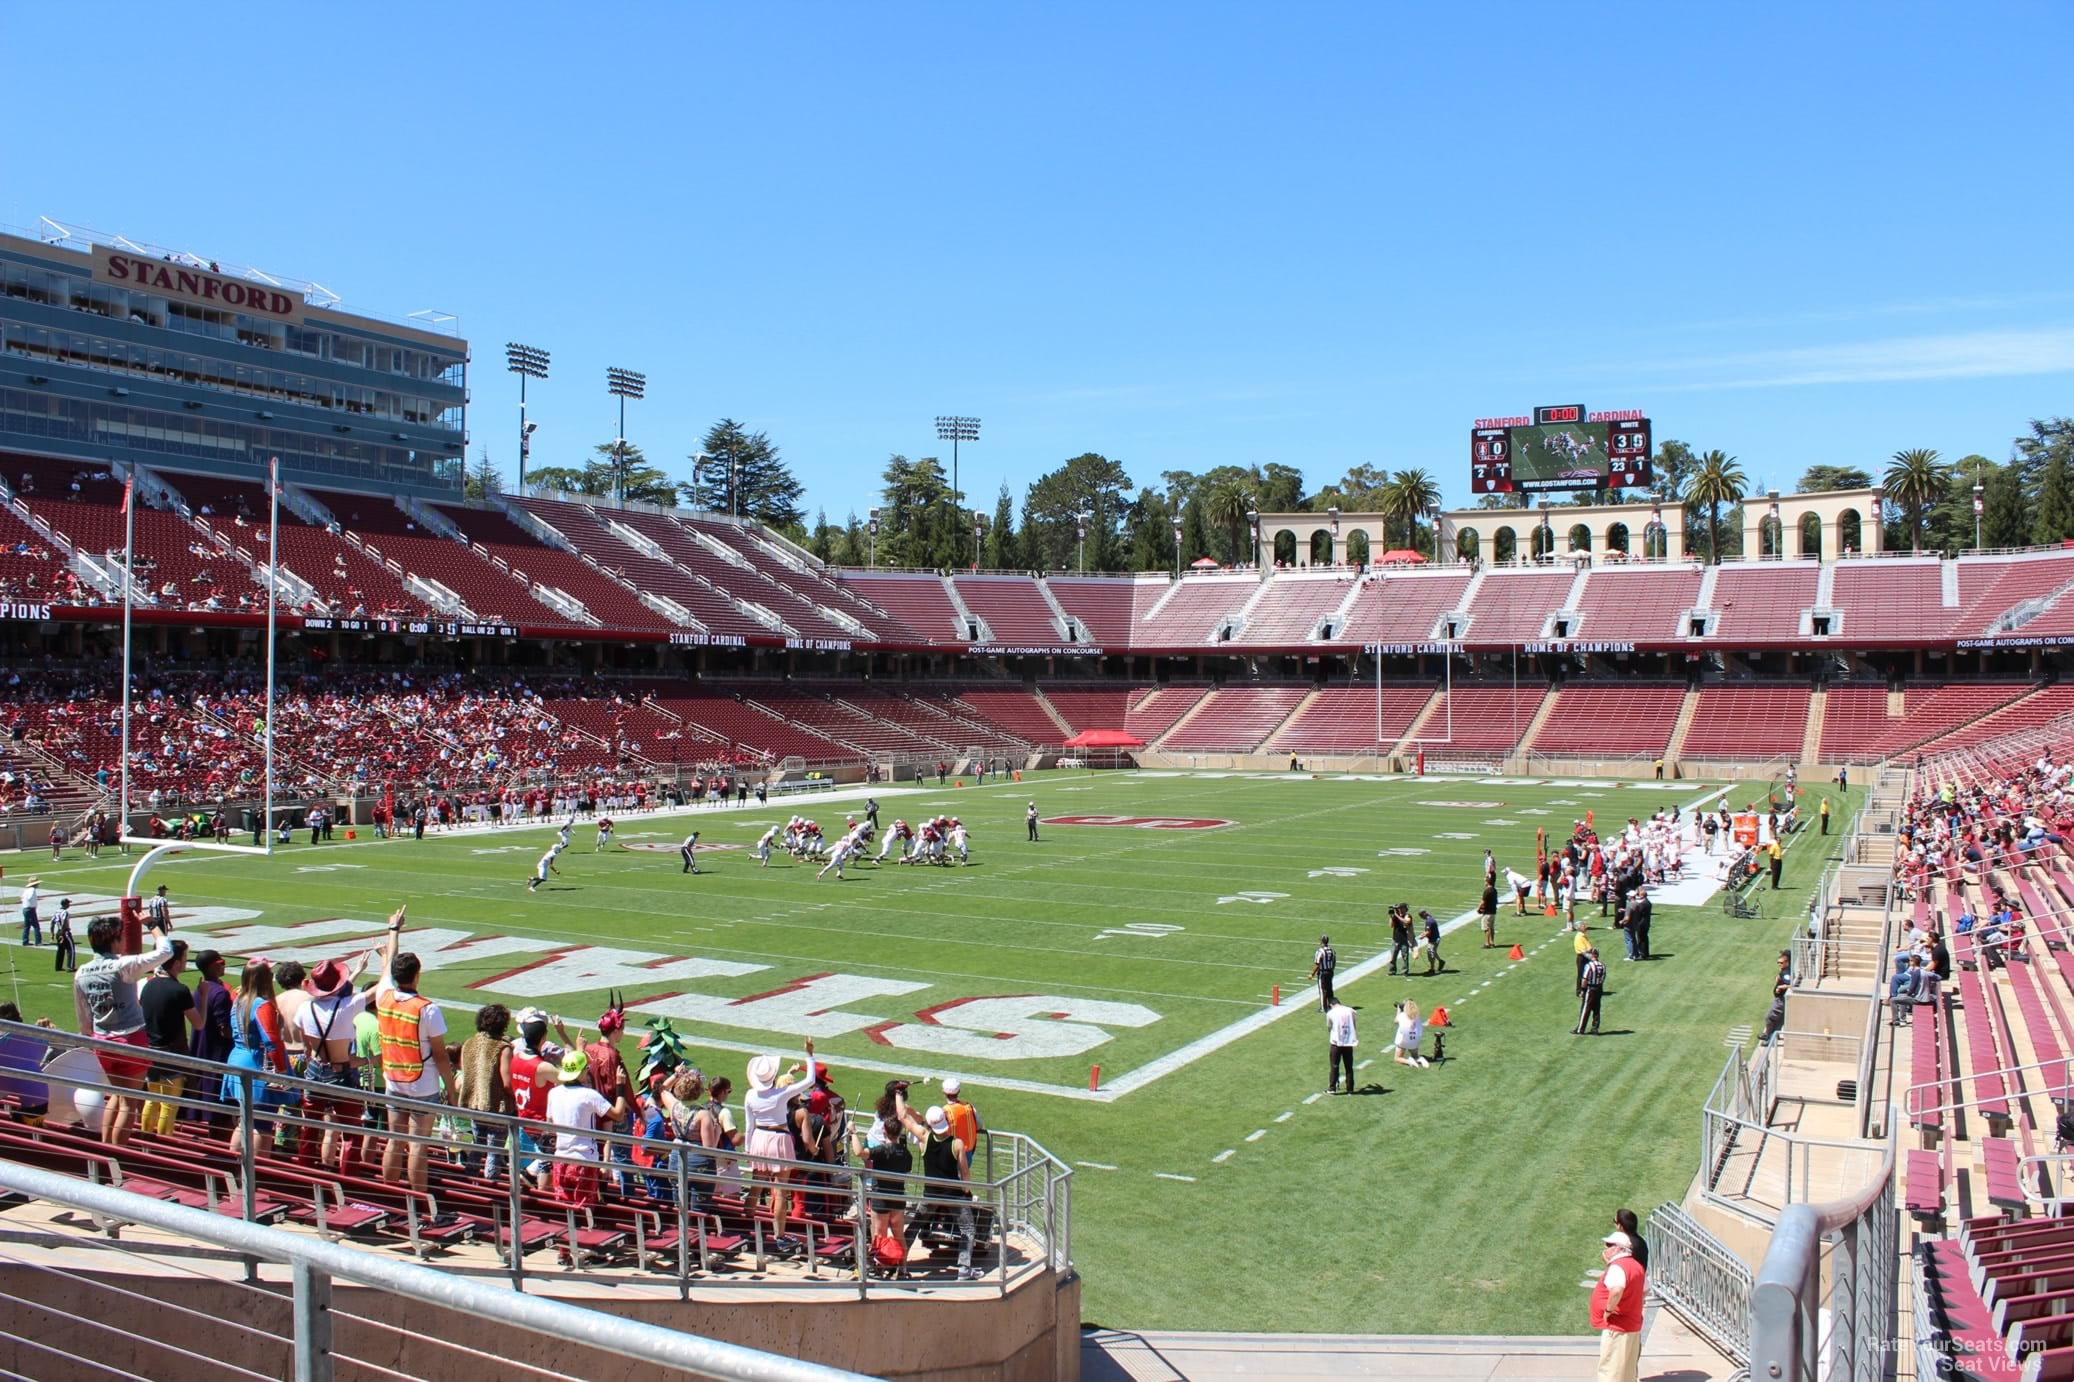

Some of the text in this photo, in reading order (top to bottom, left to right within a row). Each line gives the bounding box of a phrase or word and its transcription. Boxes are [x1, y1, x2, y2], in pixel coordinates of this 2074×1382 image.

[108, 255, 293, 315] STANFORD
[1474, 409, 1645, 429] STANFORD CARDINAL
[1550, 408, 1576, 420] 0:00
[1617, 434, 1627, 448] 3
[1493, 442, 1502, 455] 0
[1612, 462, 1625, 472] 23
[1637, 461, 1643, 471] 1
[1477, 469, 1485, 478] 2
[1500, 468, 1505, 477] 1
[0, 603, 50, 620] PIONS
[305, 618, 332, 629] DOWN 2
[341, 620, 368, 630] TO GO 1
[380, 621, 386, 631] 0
[409, 623, 428, 633] 0:00
[462, 625, 476, 634] BALL
[477, 626, 485, 634] ON
[486, 626, 495, 635] 23
[500, 627, 511, 636] QTR
[669, 633, 746, 647] STANFORD CARDINAL
[785, 638, 851, 650] HOME OF CHAMPIONS
[1957, 639, 1994, 648] POST-GAME
[1995, 637, 2043, 646] AUTOGRAPHS
[2044, 637, 2056, 645] ON
[968, 646, 1005, 654] POST-GAME
[1063, 647, 1103, 655] CONCOURSE!
[1417, 643, 1465, 653] CARDINAL
[1524, 642, 1635, 652] HOME OF CHAMPIONS
[1215, 890, 1292, 905] 20
[1092, 922, 1187, 941] 10
